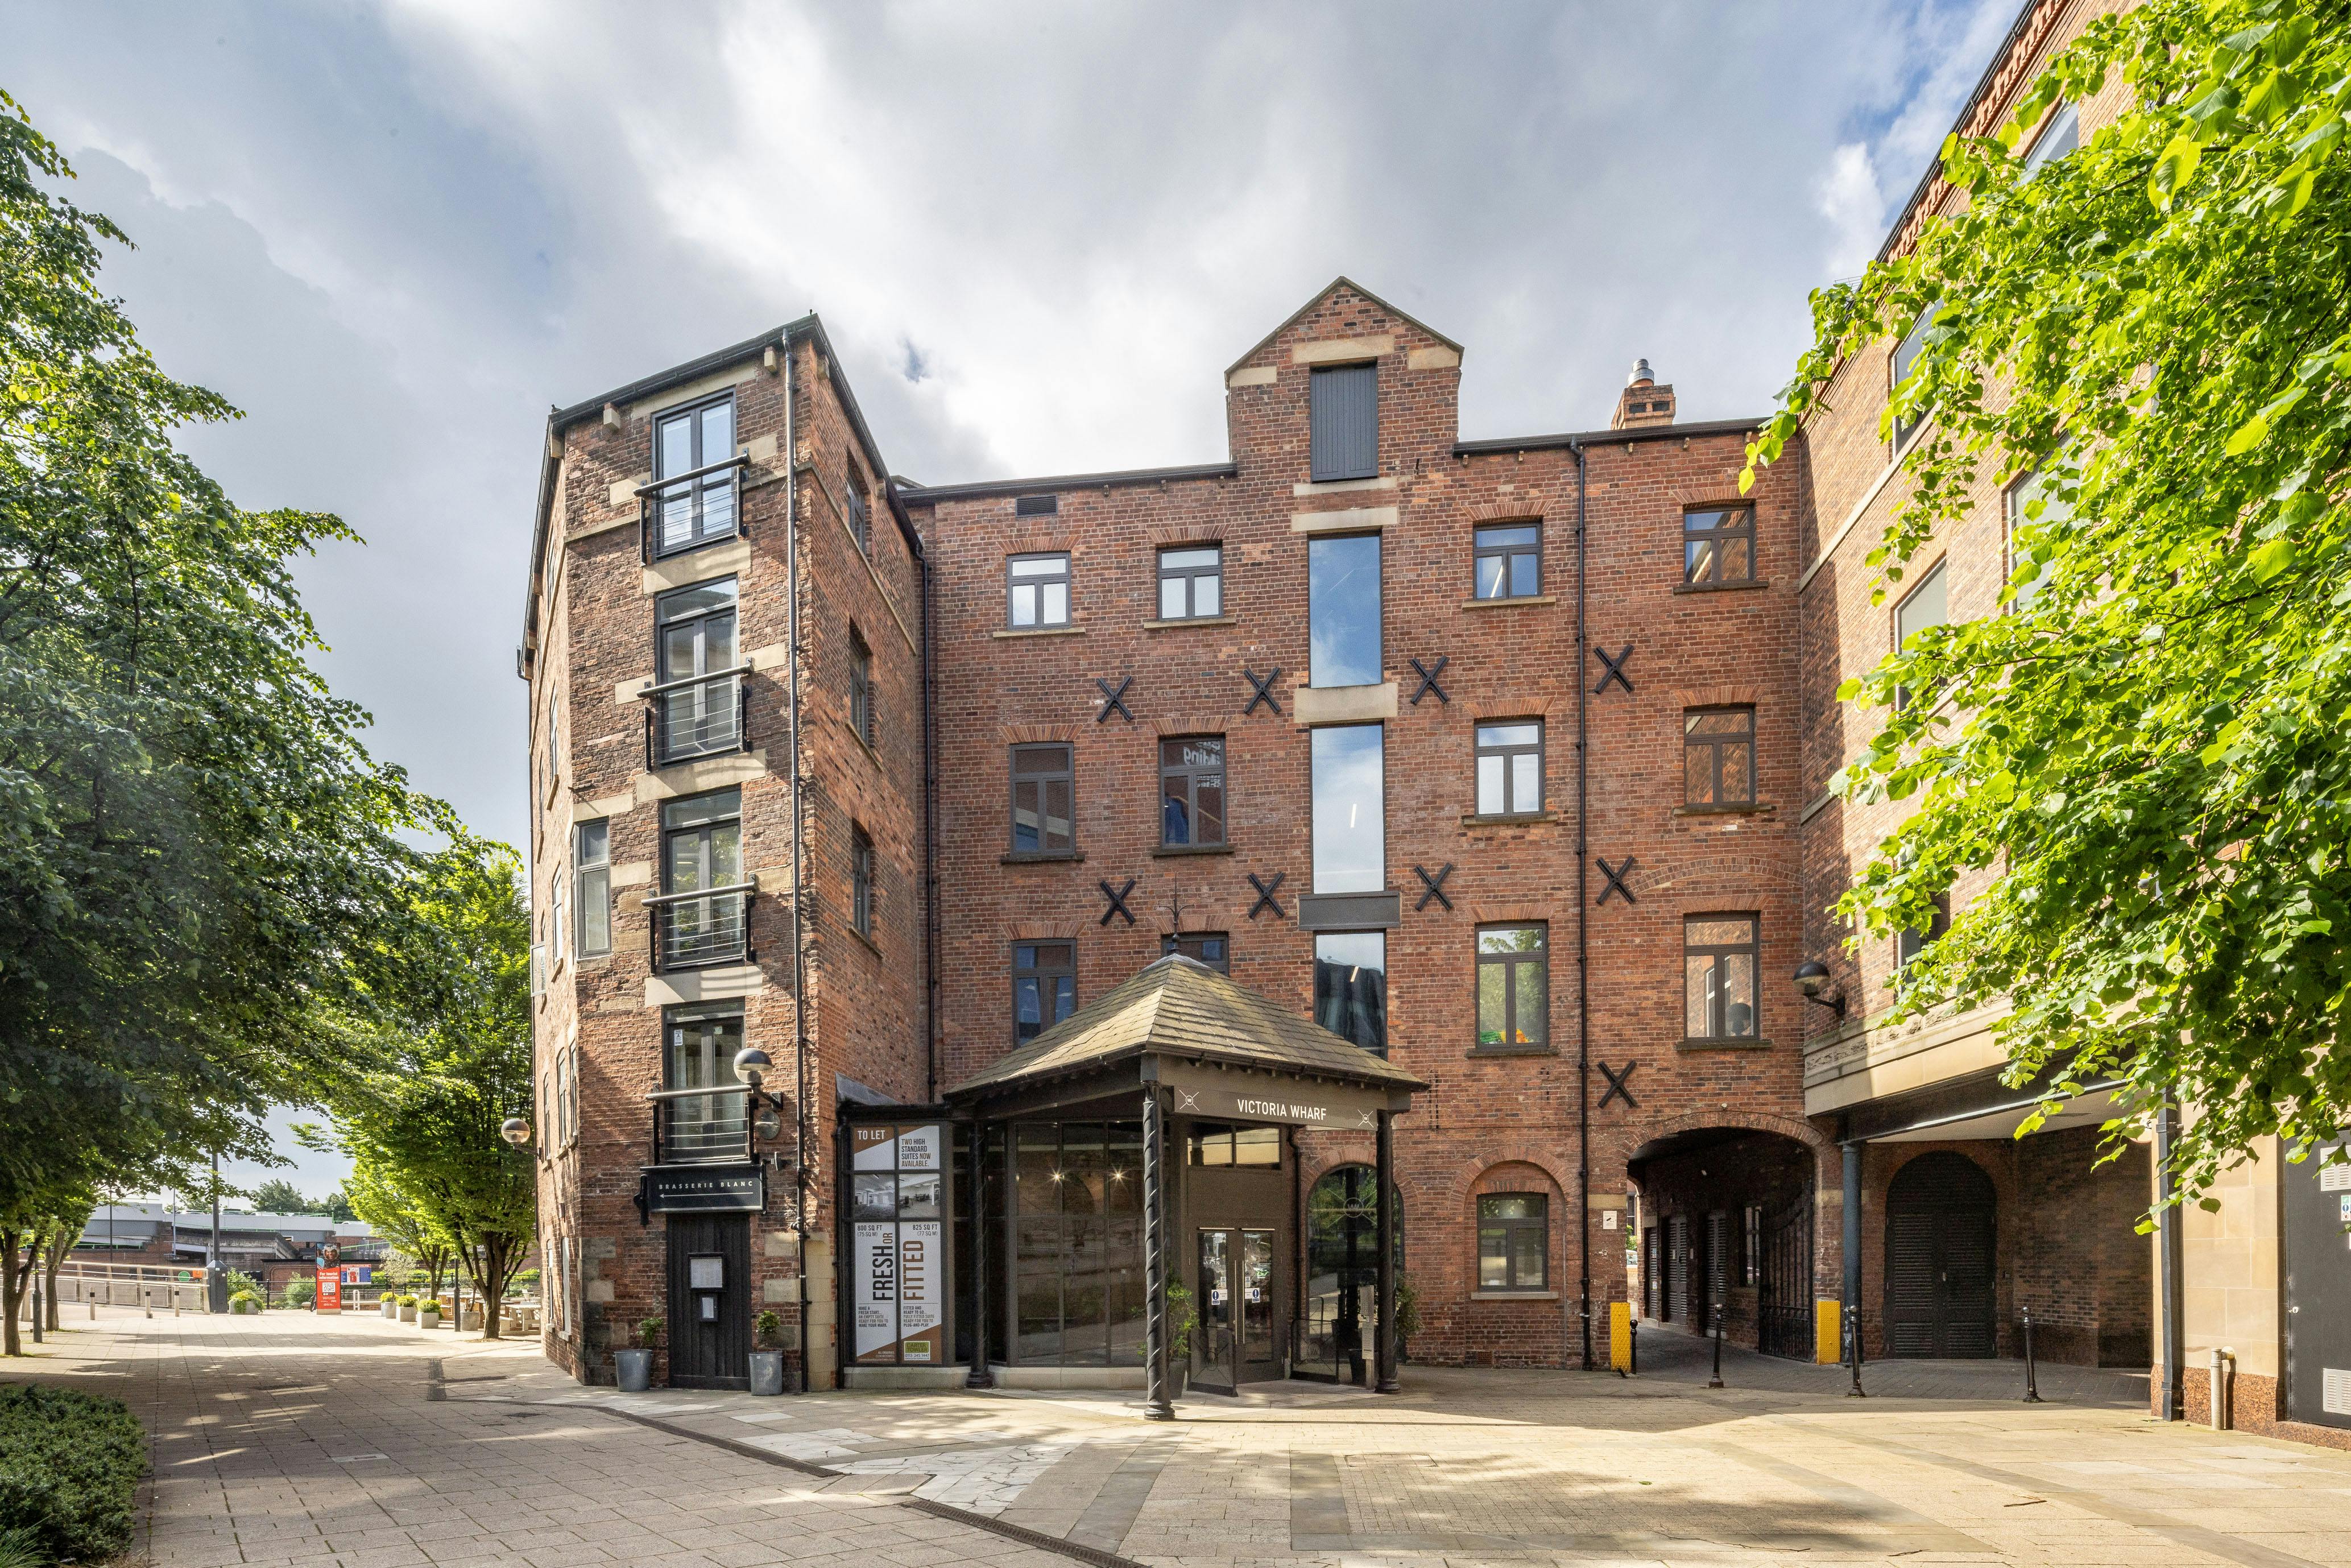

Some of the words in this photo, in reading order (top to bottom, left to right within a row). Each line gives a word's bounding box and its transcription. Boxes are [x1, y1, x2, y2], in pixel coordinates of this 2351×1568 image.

[1237, 1099, 1287, 1117] VICTORIA
[1290, 1104, 1326, 1120] WHARF
[858, 1130, 868, 1140] TO
[871, 1130, 885, 1140] LET
[872, 1246, 893, 1301] FRESH
[883, 1232, 893, 1244] OR
[903, 1240, 924, 1301] FITTED
